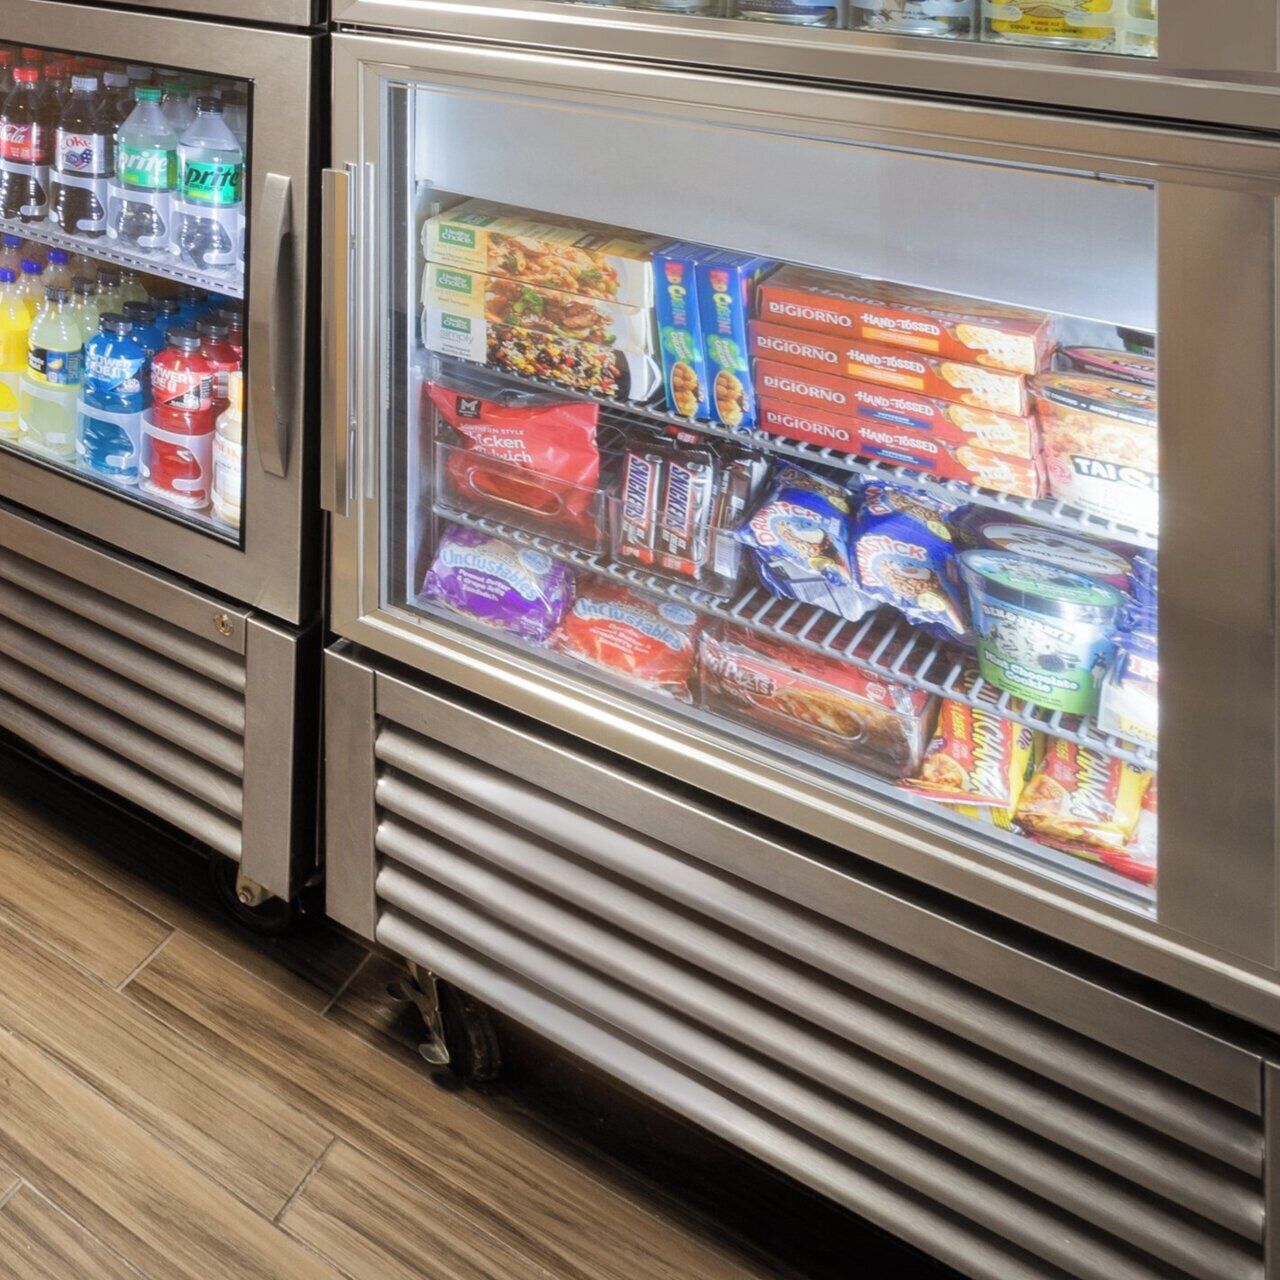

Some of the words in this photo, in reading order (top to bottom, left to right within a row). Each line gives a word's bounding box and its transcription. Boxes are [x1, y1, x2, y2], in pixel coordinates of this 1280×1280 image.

[119, 150, 168, 174] prite
[443, 226, 472, 239] Healthy
[439, 271, 469, 284] Healthy
[768, 301, 853, 328] DIGIORNO
[756, 334, 839, 364] DIGIORNO
[763, 374, 846, 404] DIGIORNO
[500, 428, 525, 436] STYLE
[766, 410, 849, 441] DIGIORNO
[1073, 456, 1118, 482] TAI
[441, 546, 538, 602] Uncrustables
[575, 597, 683, 651] Uncrustables
[1004, 670, 1053, 693] Cookie
[1009, 661, 1080, 691] Chocolate
